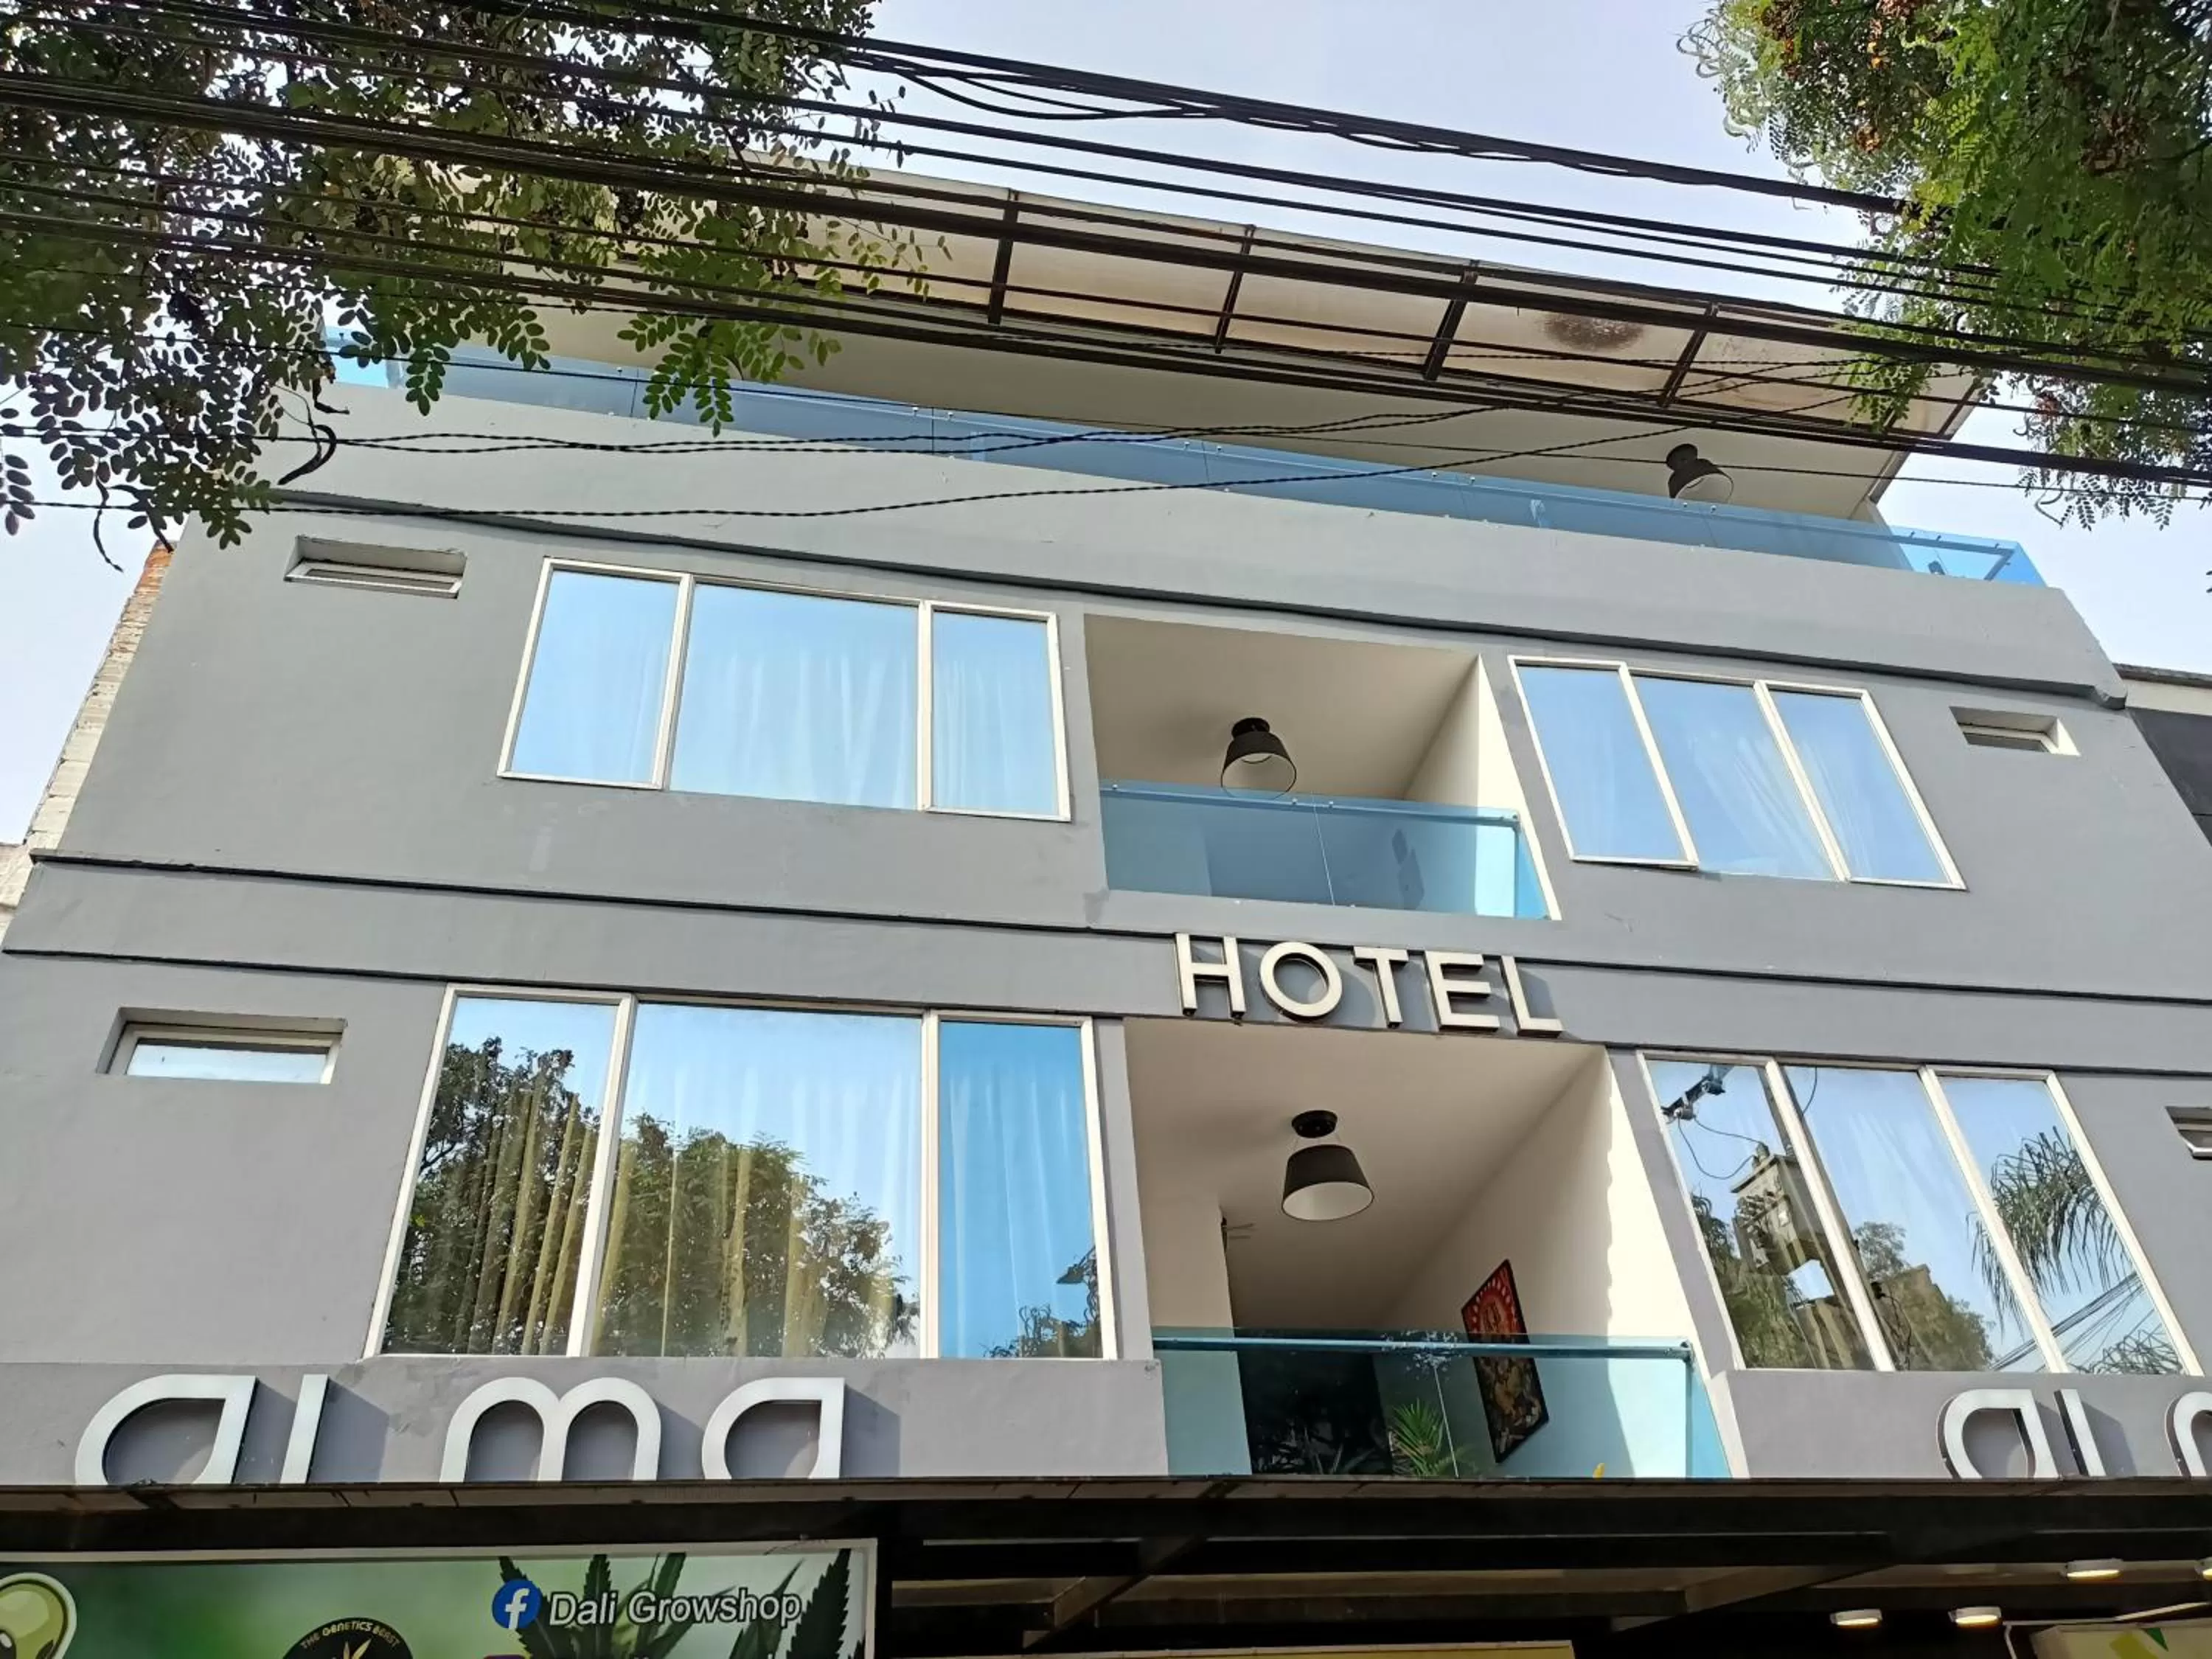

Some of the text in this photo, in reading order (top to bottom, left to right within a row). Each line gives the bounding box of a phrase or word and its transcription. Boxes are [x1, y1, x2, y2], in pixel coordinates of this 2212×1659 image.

[1175, 933, 1563, 1037] HOTEL
[1936, 1388, 2212, 1478] al
[549, 1591, 617, 1625] Dali
[628, 1587, 802, 1626] Growshop
